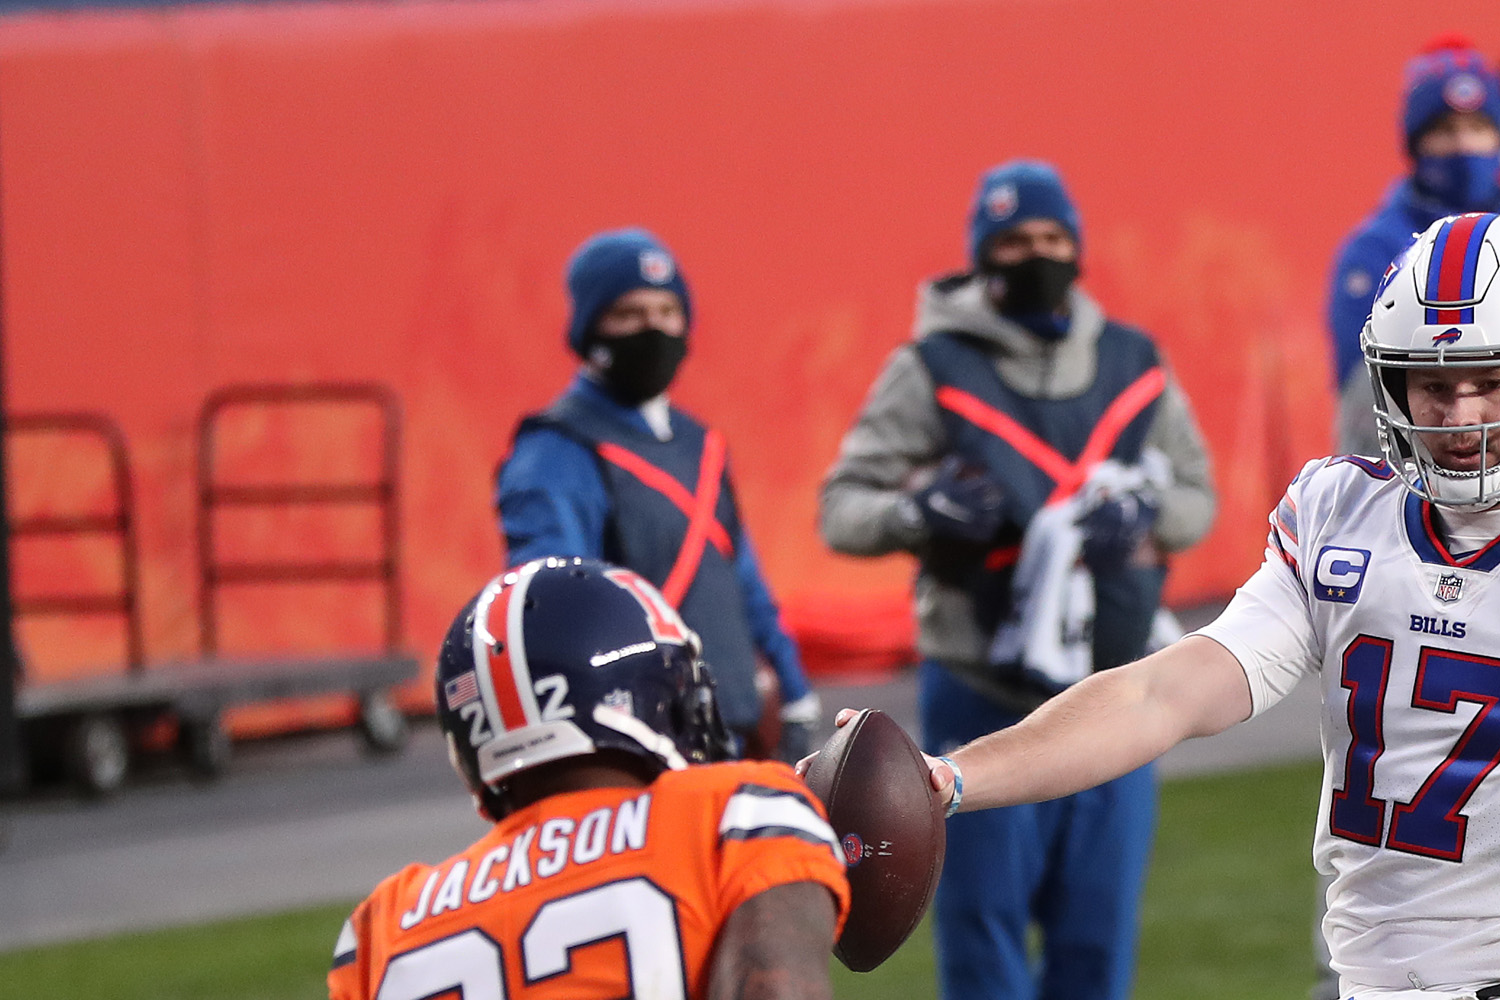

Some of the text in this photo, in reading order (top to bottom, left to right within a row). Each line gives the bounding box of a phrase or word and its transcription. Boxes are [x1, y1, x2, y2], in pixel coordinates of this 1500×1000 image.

[1316, 549, 1365, 588] C
[1438, 585, 1458, 600] NFL
[1409, 614, 1467, 638] BILLS
[400, 793, 652, 930] JACKSON
